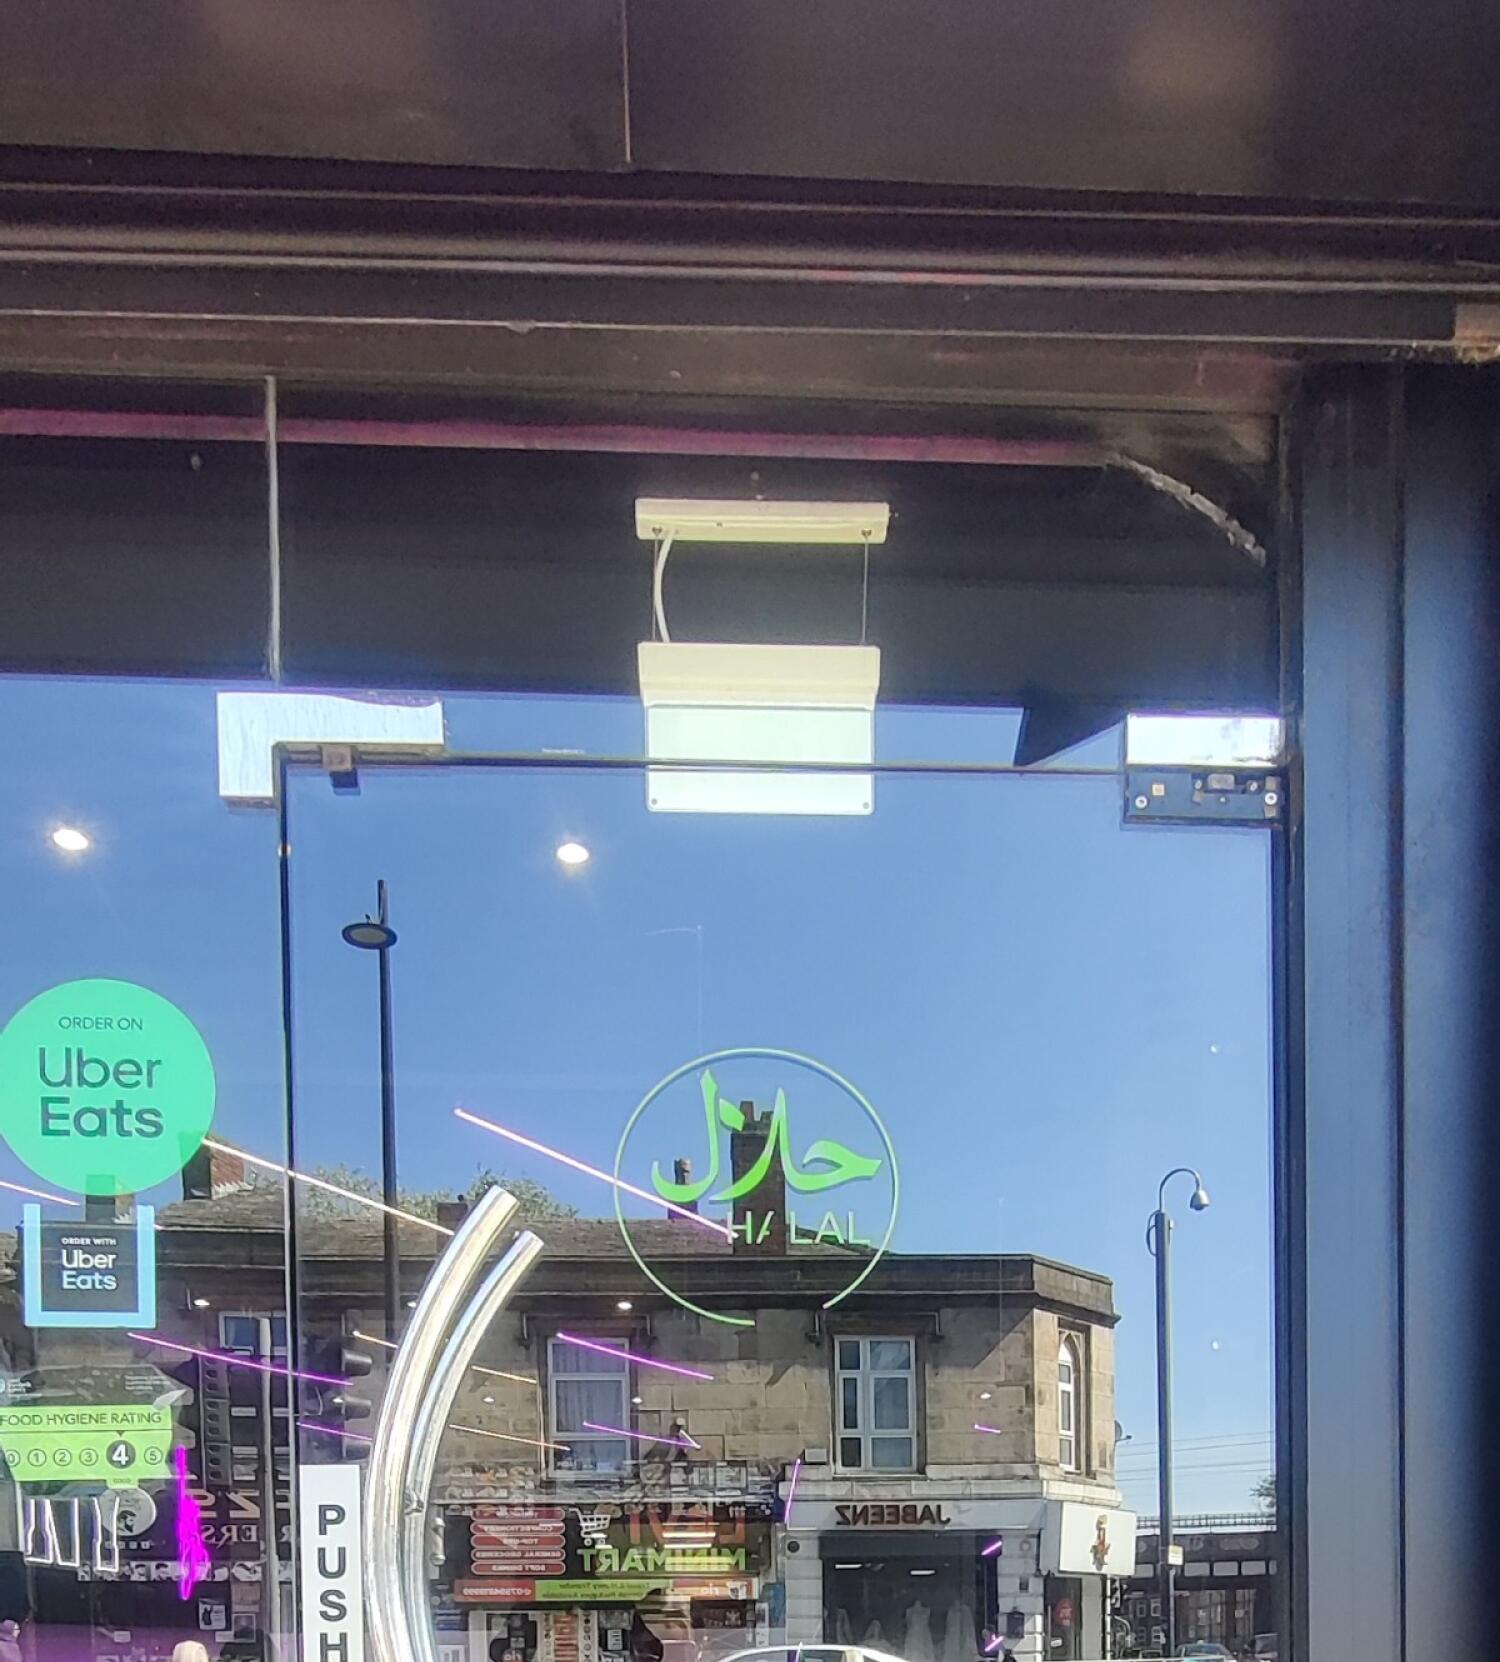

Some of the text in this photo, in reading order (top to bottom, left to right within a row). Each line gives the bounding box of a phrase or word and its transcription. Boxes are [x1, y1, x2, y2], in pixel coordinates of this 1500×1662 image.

[58, 1016, 143, 1030] ORDER ON
[38, 1047, 163, 1089] Uber
[40, 1096, 164, 1138] Eats
[651, 1067, 882, 1204] حلال
[61, 1237, 117, 1246] ORDER WITH
[61, 1249, 117, 1269] Uber
[62, 1270, 117, 1290] Eats
[0, 1412, 161, 1426] FOOD HYGIENE RATING
[112, 1444, 130, 1466] 4
